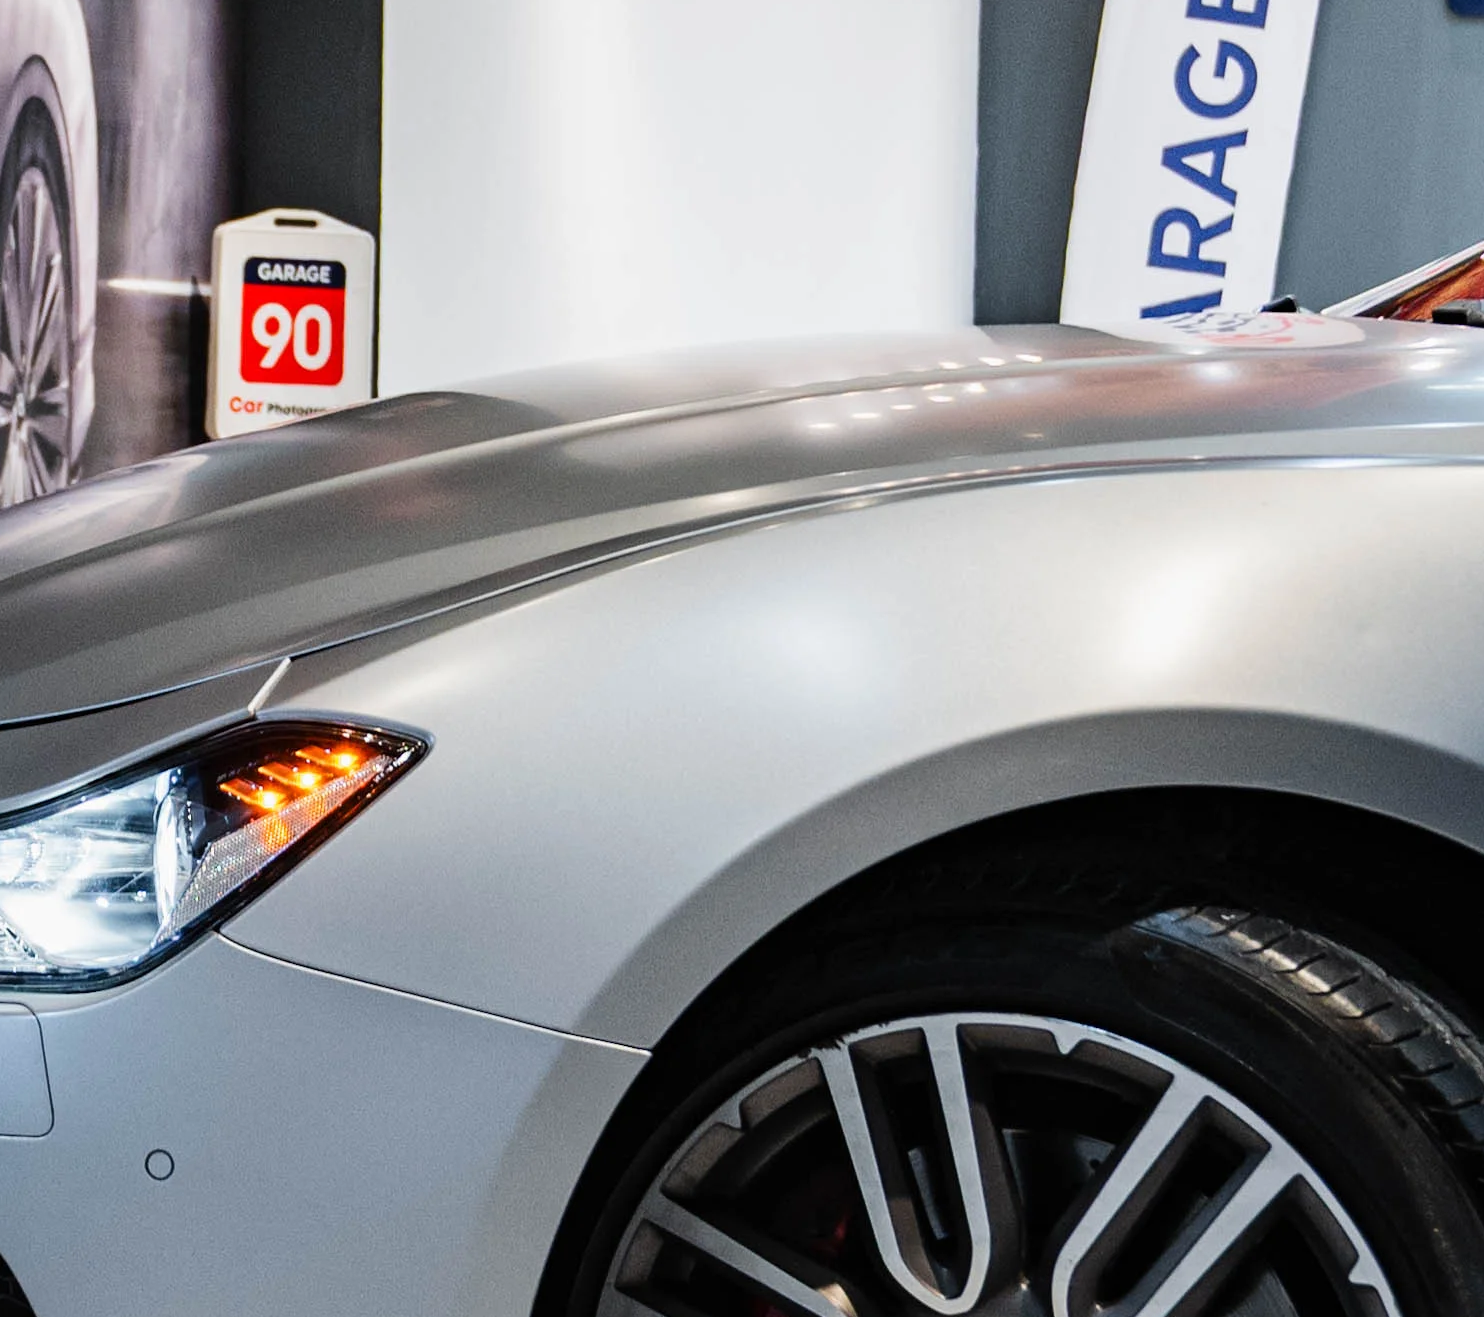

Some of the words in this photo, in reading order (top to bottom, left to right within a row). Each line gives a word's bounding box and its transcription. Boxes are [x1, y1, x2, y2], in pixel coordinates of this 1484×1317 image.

[257, 262, 332, 284] GARAGE
[251, 302, 332, 371] 90
[229, 396, 263, 413] Car
